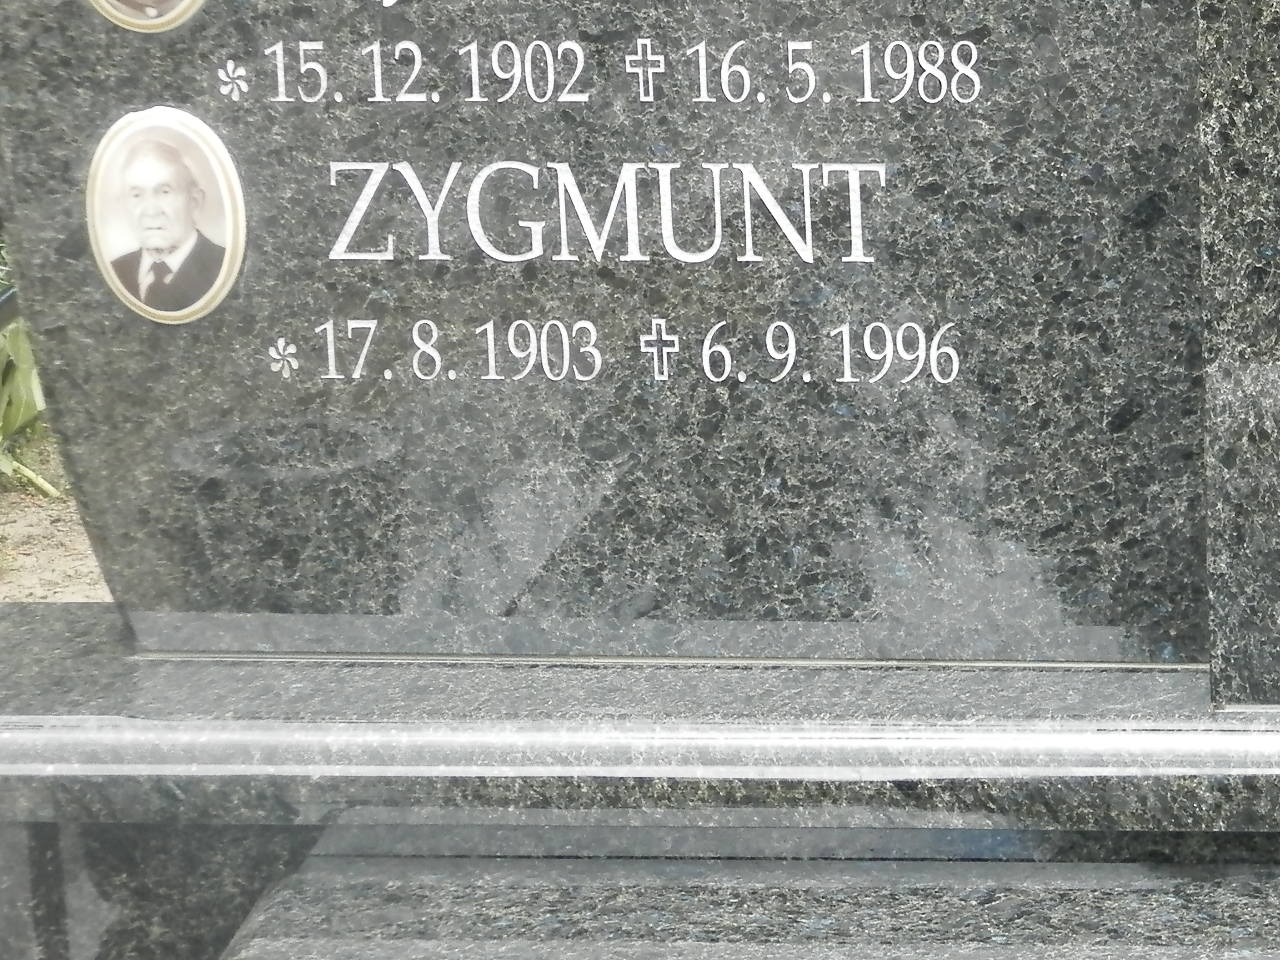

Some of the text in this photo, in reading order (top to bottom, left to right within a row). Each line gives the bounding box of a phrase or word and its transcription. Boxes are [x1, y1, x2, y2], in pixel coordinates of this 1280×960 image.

[265, 40, 982, 105] 15. 12. 1902 16. 5. 1988
[328, 159, 887, 267] ZYGMUNT
[314, 321, 961, 384] 17. 8. 1903 6. 9. 1996
